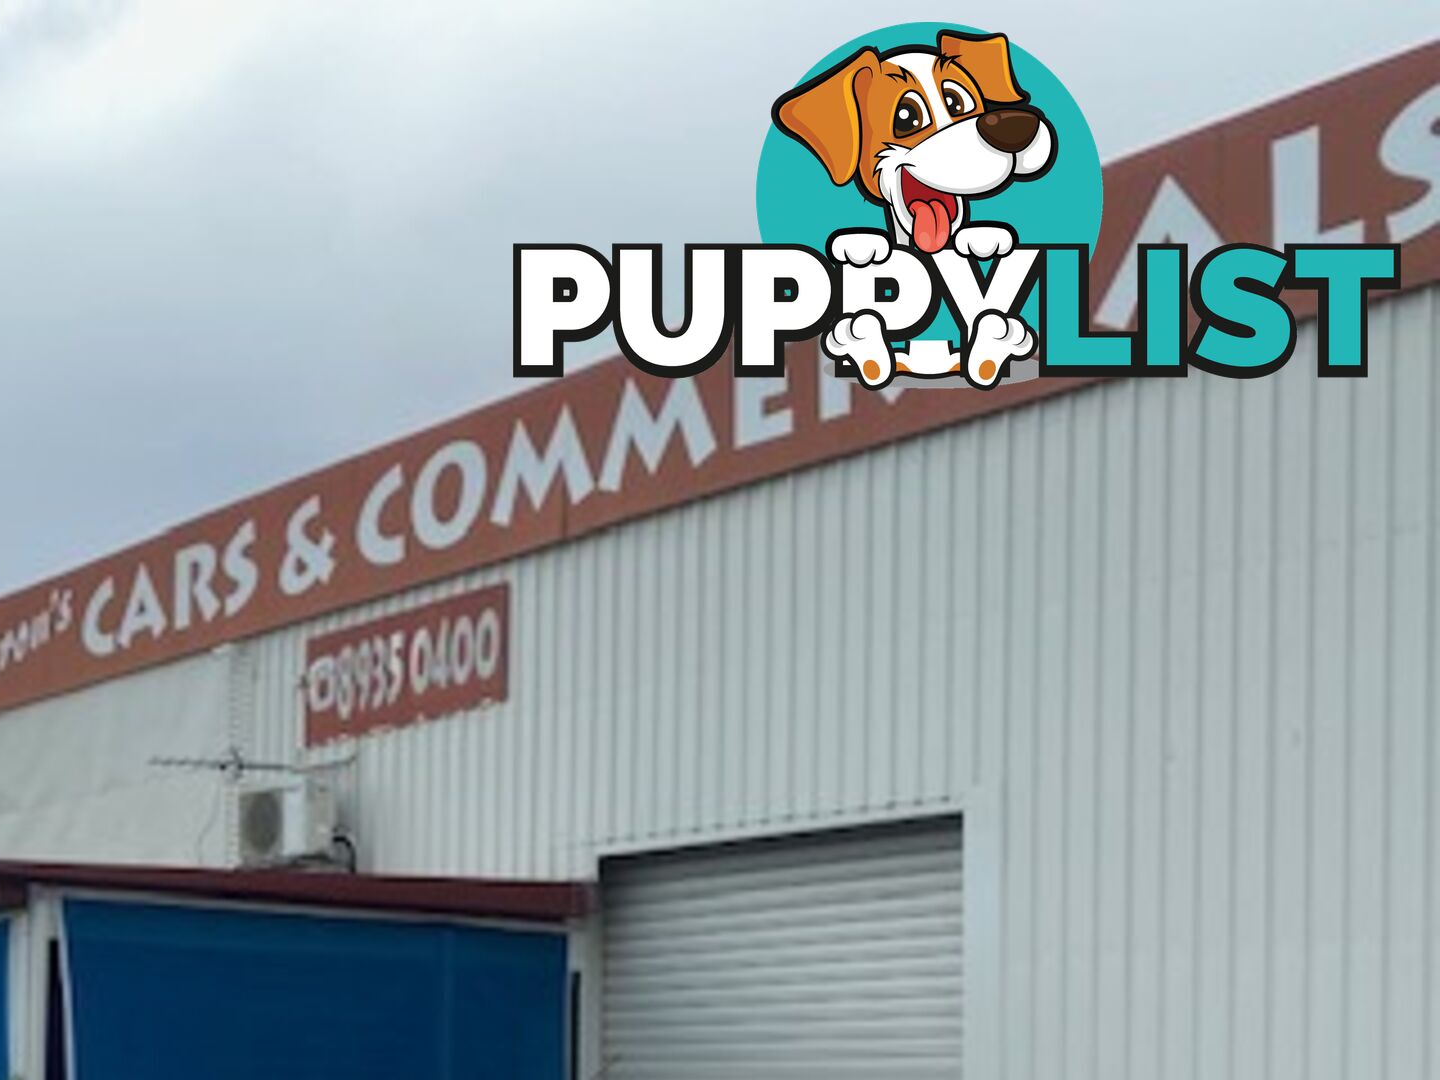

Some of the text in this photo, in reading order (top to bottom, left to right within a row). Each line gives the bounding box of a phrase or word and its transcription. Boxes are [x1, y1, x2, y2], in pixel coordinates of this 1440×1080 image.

[80, 518, 259, 656] CARS
[279, 494, 336, 596] &
[335, 607, 500, 721] 8935 0400
